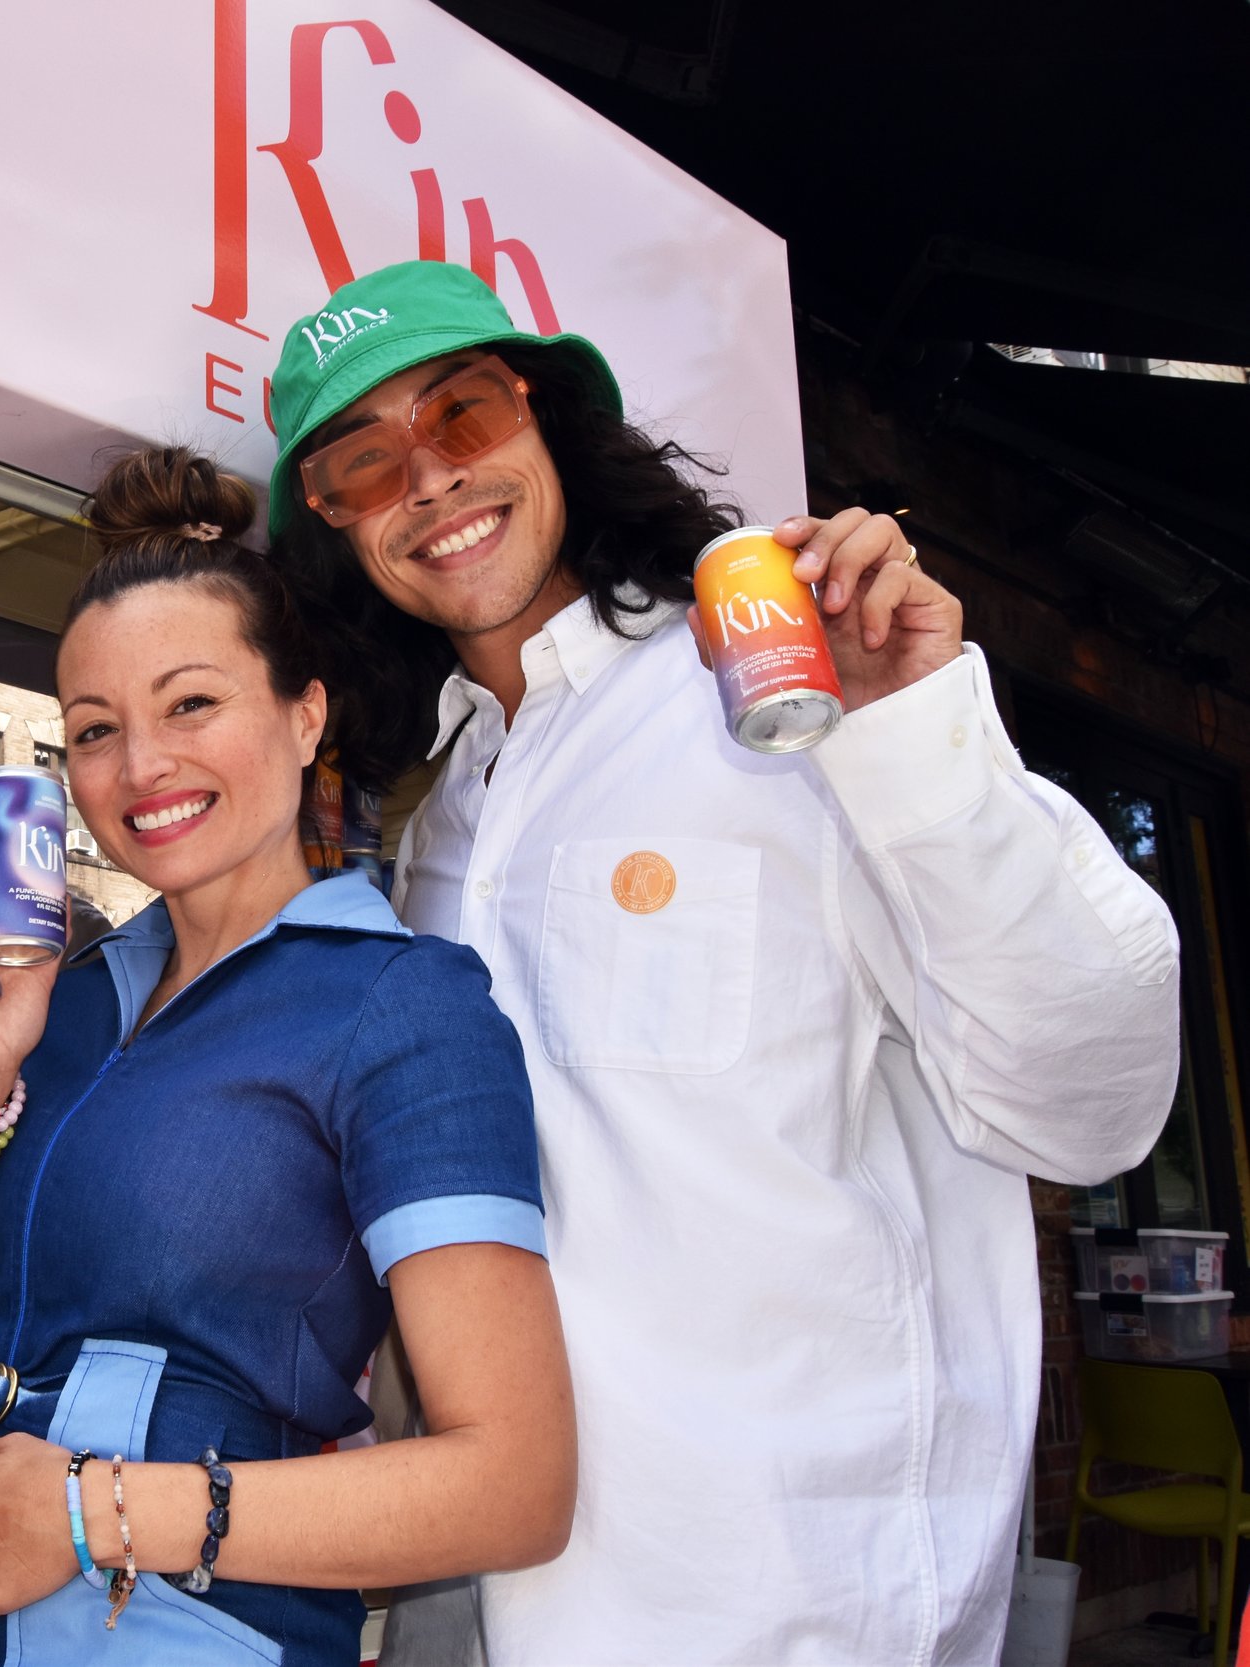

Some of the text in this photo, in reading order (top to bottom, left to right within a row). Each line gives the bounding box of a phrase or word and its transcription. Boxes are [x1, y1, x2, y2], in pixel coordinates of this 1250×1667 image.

[302, 307, 388, 364] Kin
[715, 590, 803, 648] Kin
[729, 649, 776, 674] FUNCTIONAL
[777, 645, 818, 653] BEVERAGE
[744, 654, 781, 672] MODERN
[782, 651, 815, 659] RITUALS
[770, 674, 808, 684] SUPPLEMENT
[19, 821, 67, 880] Kin
[628, 864, 657, 900] K
